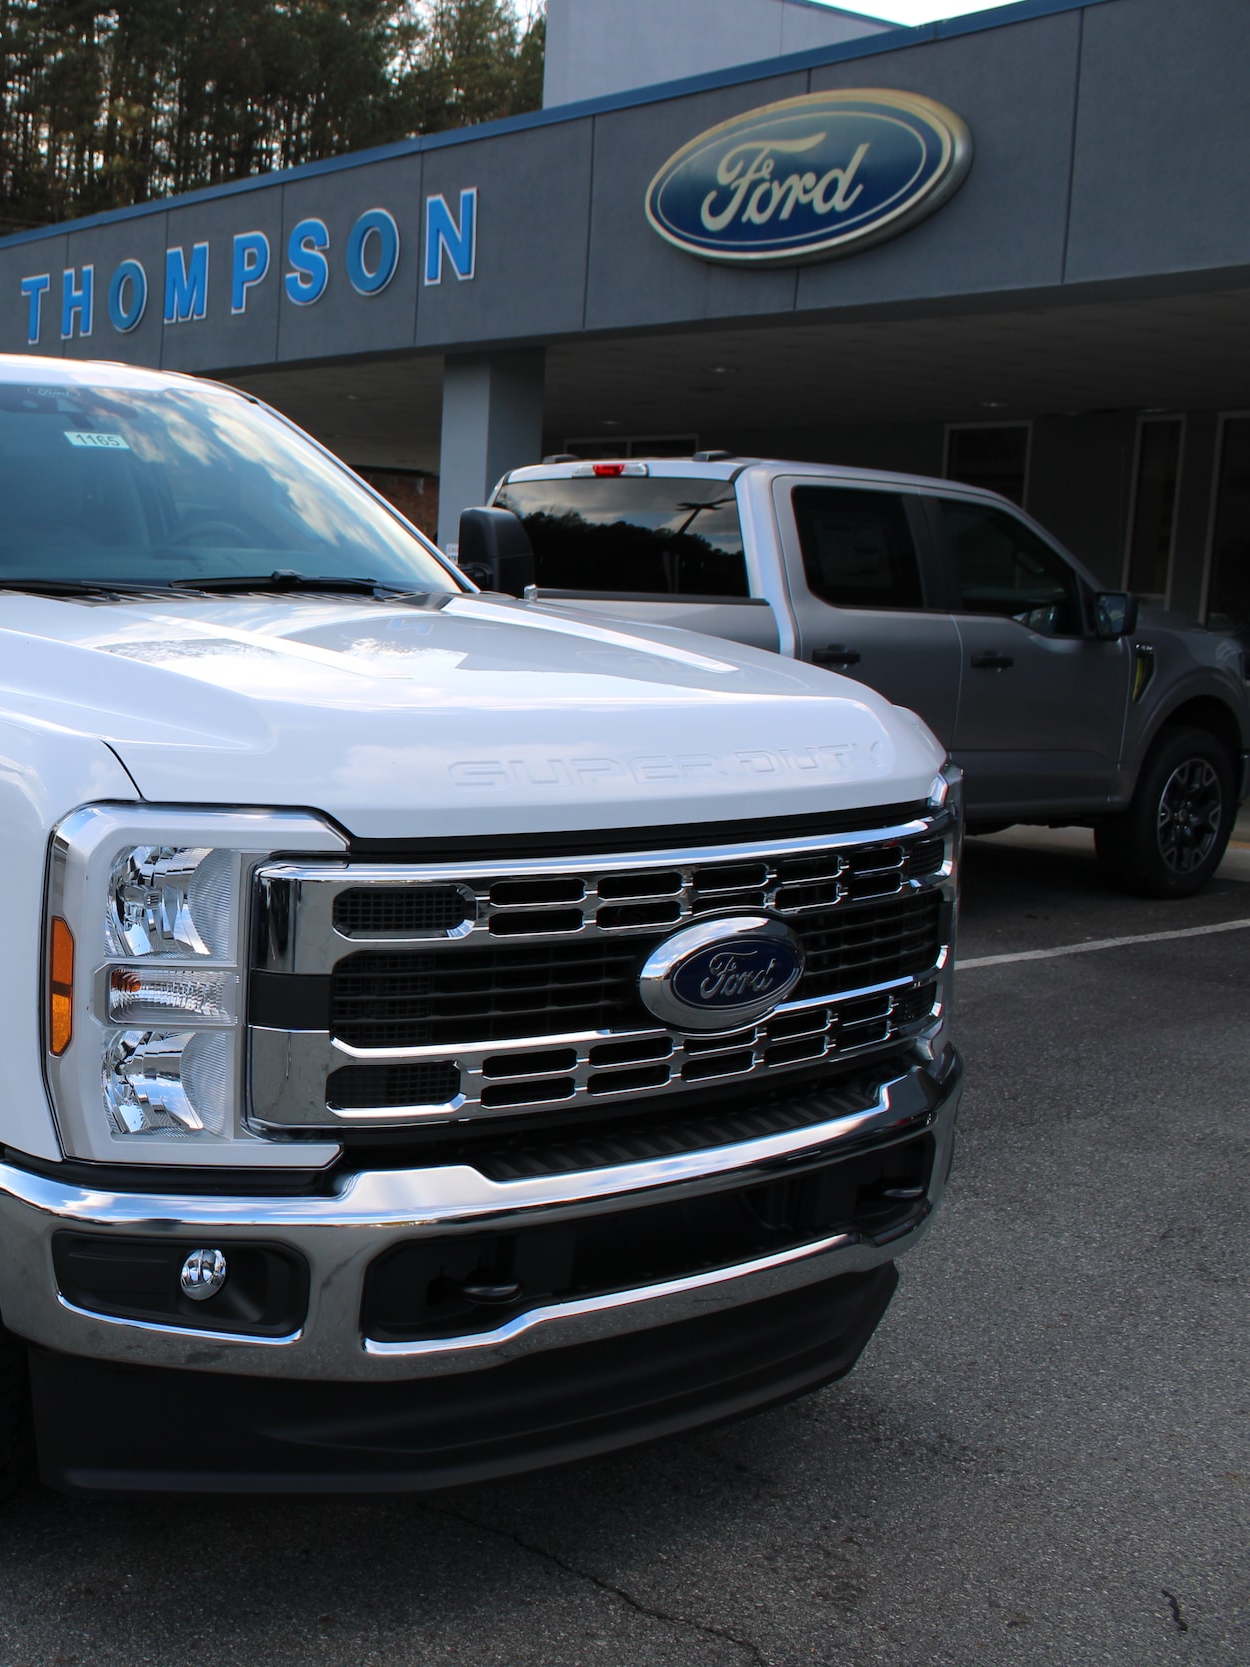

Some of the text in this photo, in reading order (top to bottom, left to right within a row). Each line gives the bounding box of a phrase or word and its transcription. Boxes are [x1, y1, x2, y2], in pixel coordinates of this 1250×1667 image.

[701, 132, 871, 232] Ford
[20, 187, 479, 346] THOMPSON
[76, 433, 121, 447] 1165
[447, 752, 729, 792] SUPER
[700, 950, 776, 999] Ford
